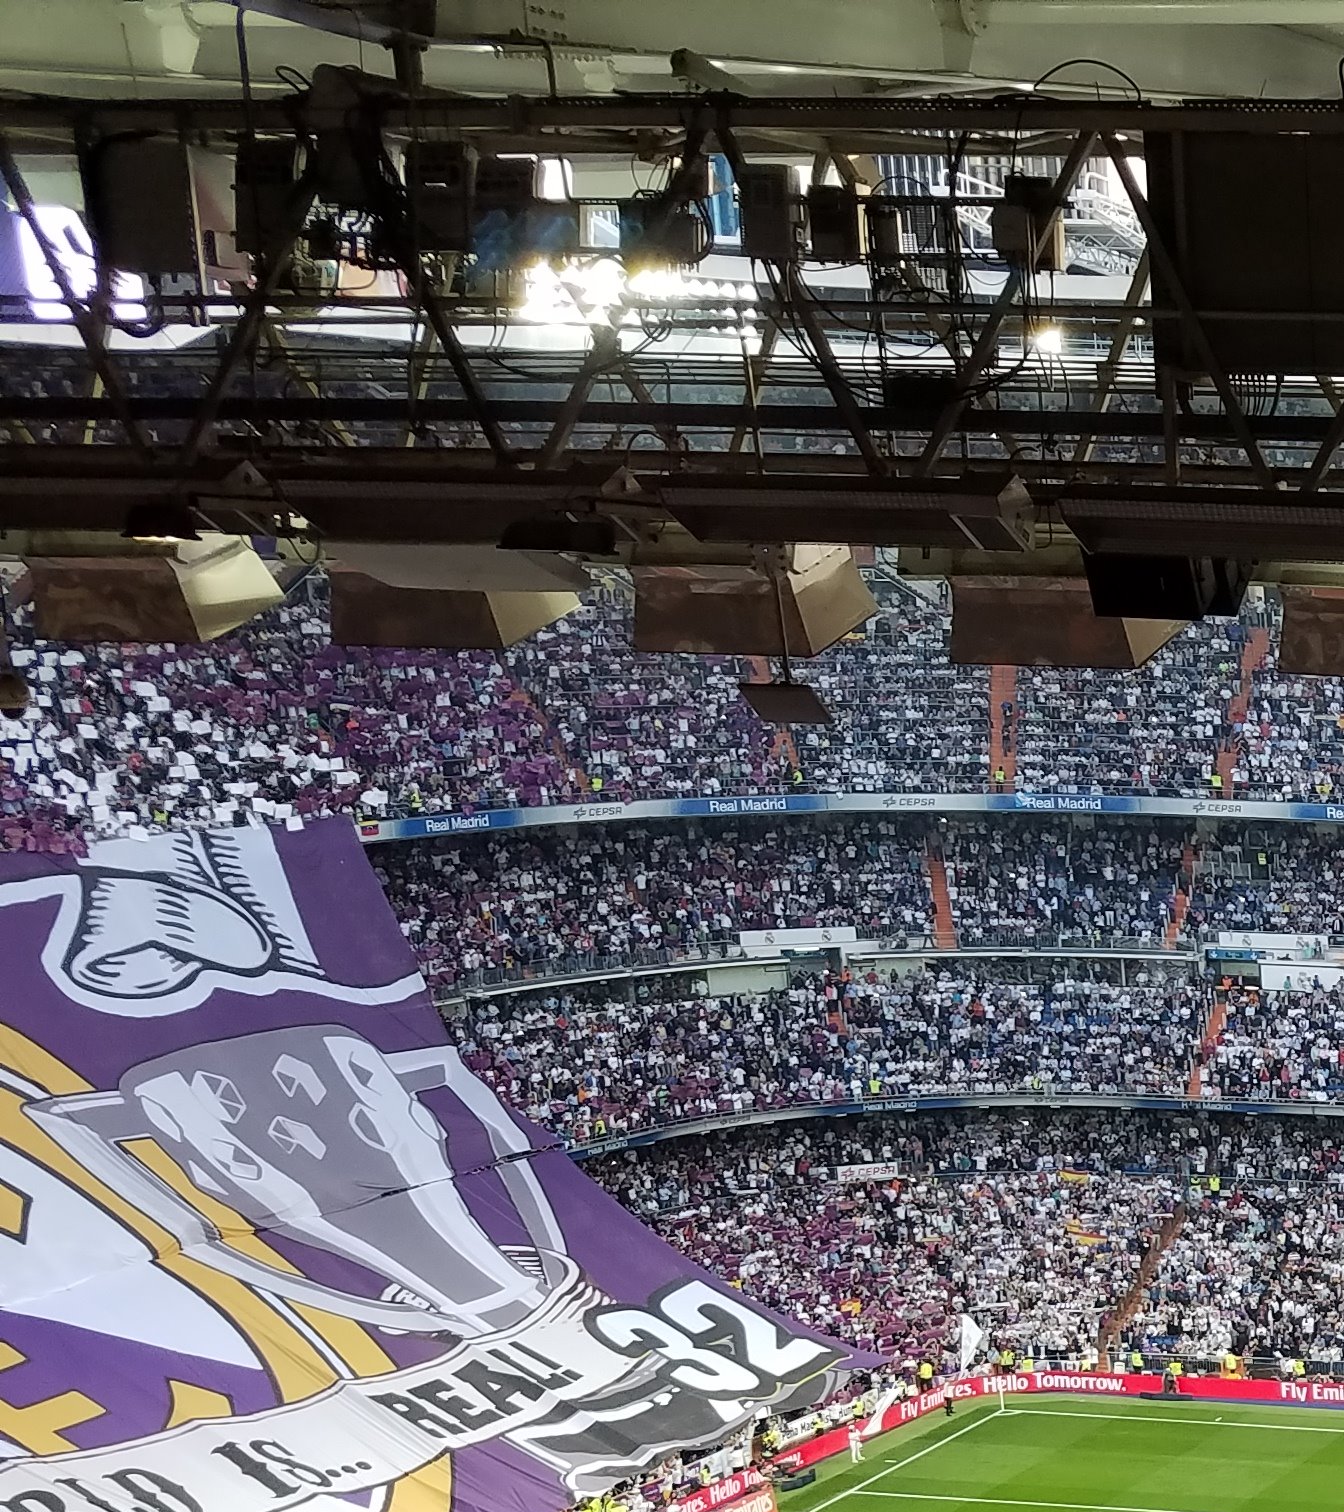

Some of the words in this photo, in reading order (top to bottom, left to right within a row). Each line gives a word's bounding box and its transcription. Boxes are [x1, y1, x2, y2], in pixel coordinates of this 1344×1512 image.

[710, 799, 735, 812] Real
[740, 797, 786, 812] Madrid
[899, 797, 935, 807] CEPSA
[1027, 797, 1052, 809] Real
[1056, 797, 1101, 810] Madrid
[1207, 803, 1241, 813] CEPSA
[589, 806, 622, 817] CEPSA
[426, 819, 448, 832] Real
[452, 814, 489, 830] Madrid
[885, 1101, 917, 1109] Madrid
[858, 1165, 895, 1176] CEPSA
[592, 1278, 840, 1398] 32
[375, 1339, 584, 1439] REAL!
[901, 1401, 918, 1418] Fly
[984, 1373, 1028, 1393] Hello
[1035, 1373, 1127, 1392] Tomorrow.
[1281, 1382, 1307, 1402] Fly
[710, 1479, 741, 1506] Hello
